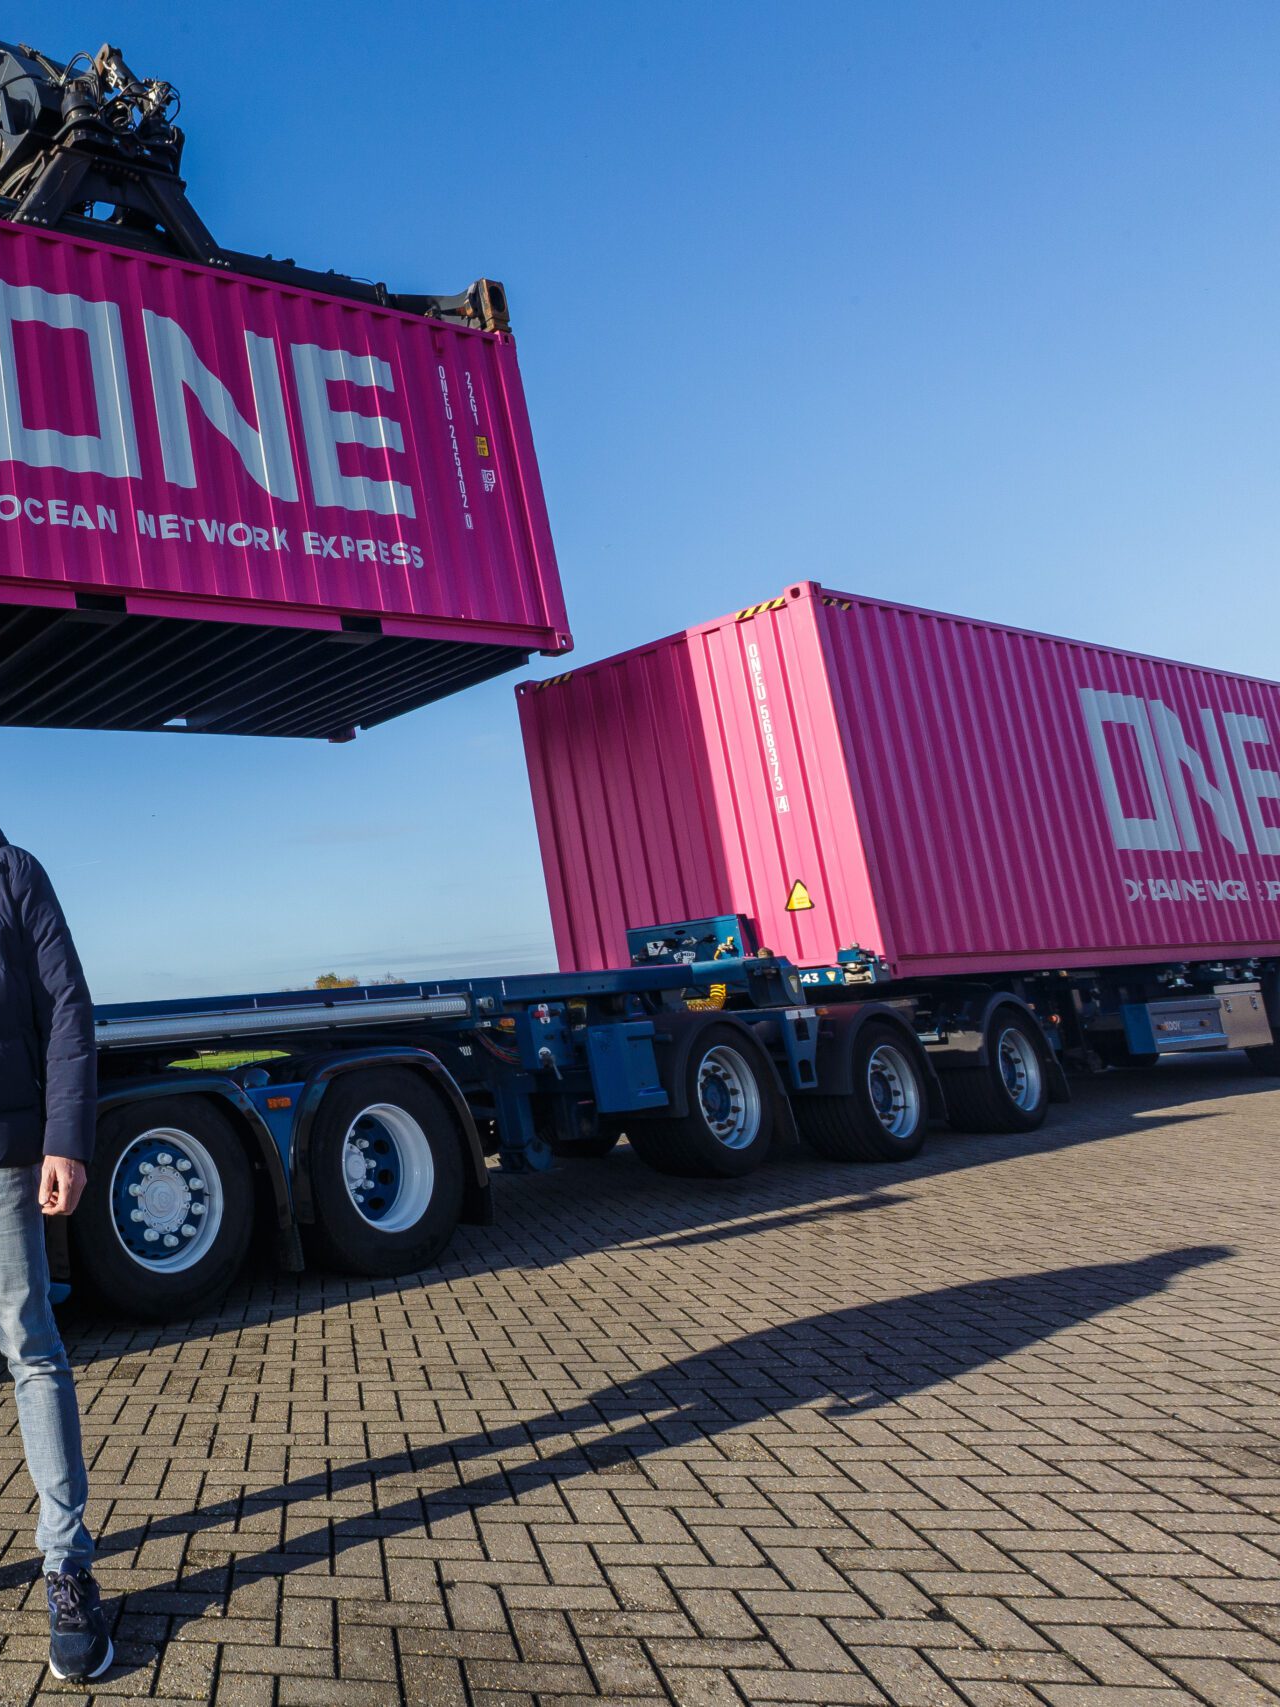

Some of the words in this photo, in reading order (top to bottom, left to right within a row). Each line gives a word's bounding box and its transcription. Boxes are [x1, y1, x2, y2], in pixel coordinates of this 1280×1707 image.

[438, 365, 453, 420] ONEU
[449, 425, 468, 508] 245402
[465, 371, 479, 426] 22G1
[138, 513, 291, 553] NETWORK
[303, 530, 424, 569] EXPRESS
[748, 643, 767, 701] ONEU
[760, 704, 783, 792] 568373
[776, 795, 789, 813] 4
[1079, 687, 1280, 855] ONE
